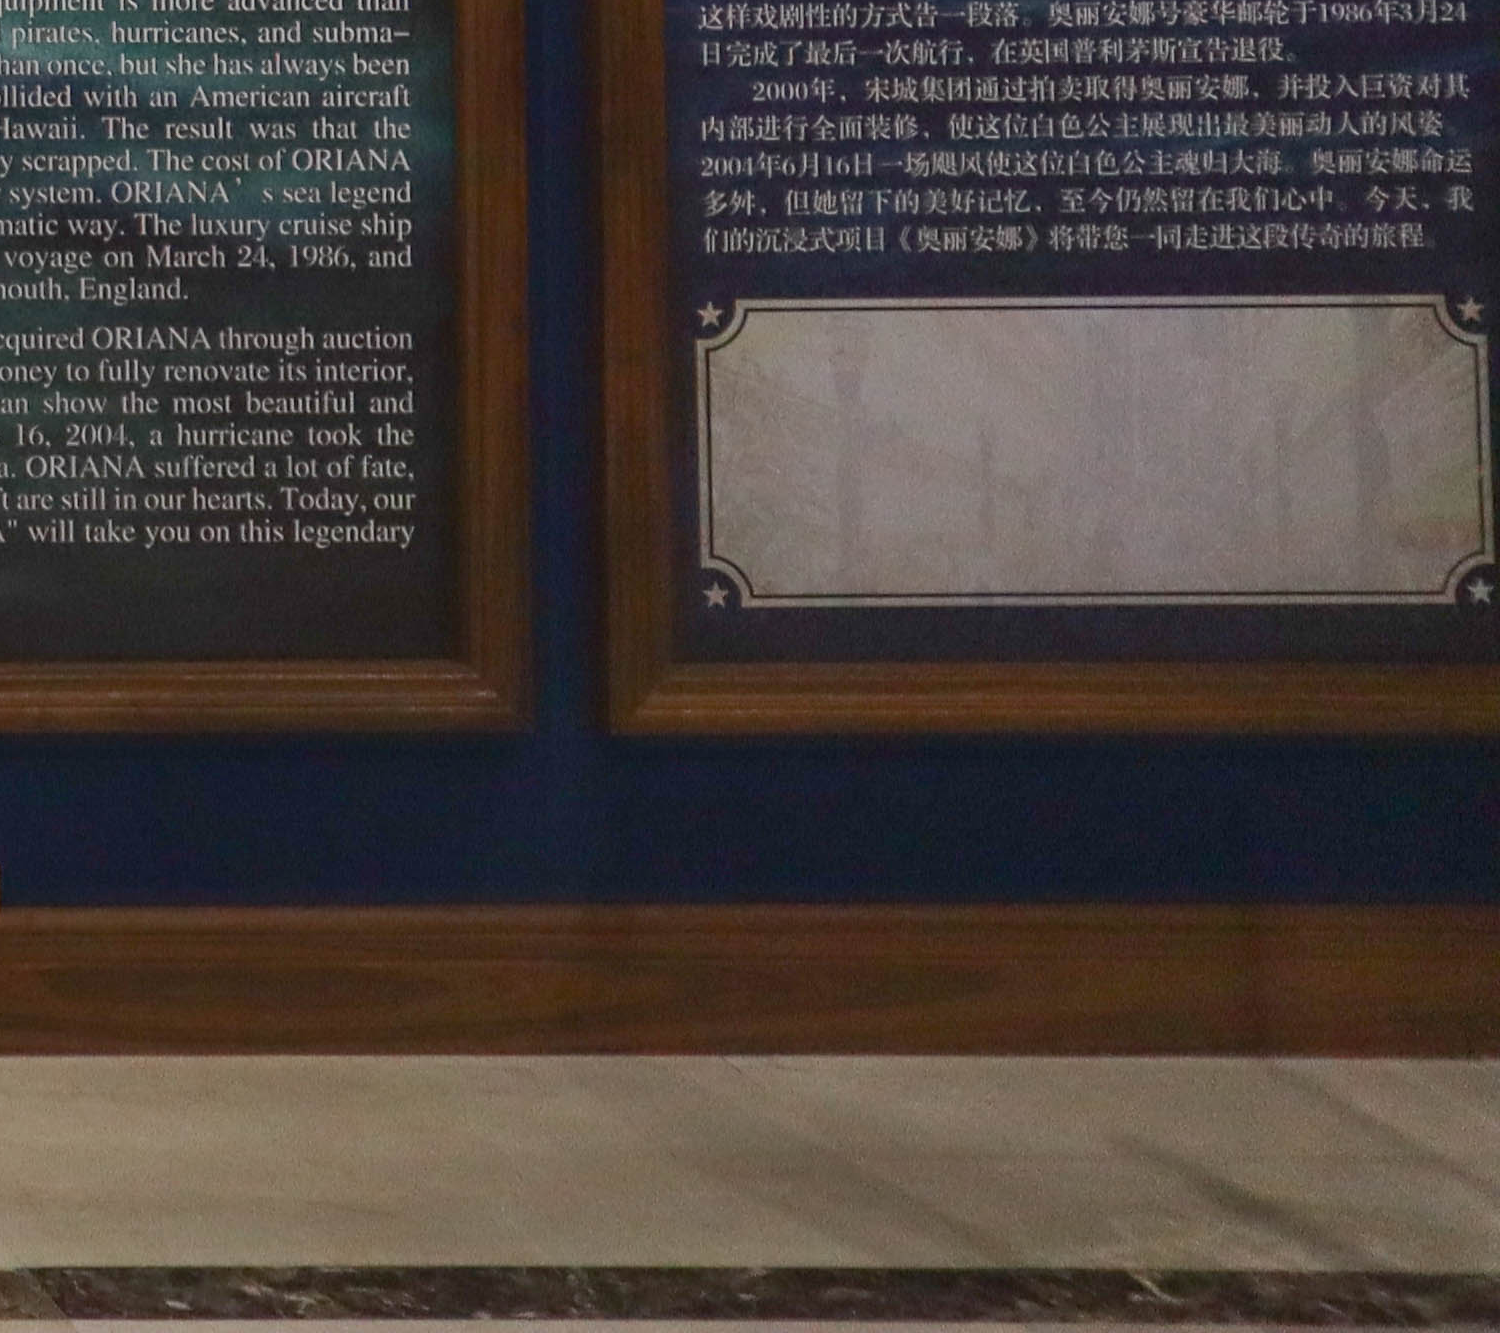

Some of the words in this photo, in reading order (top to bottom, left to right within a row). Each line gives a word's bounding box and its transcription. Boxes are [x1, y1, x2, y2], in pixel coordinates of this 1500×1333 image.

[67, 218, 125, 242] way.
[133, 212, 183, 237] The
[191, 212, 270, 242] luxury
[278, 211, 353, 236] cruise
[360, 211, 413, 242] ship
[16, 423, 52, 448] 16,
[65, 423, 135, 449] 2004,
[149, 429, 163, 447] a
[176, 421, 294, 447] hurricane
[307, 422, 363, 447] took
[376, 421, 415, 447] the
[16, 493, 54, 511] are
[60, 486, 106, 511] still
[114, 486, 137, 511] in
[143, 493, 187, 511] our
[191, 486, 273, 511] hearts.
[279, 485, 367, 516] Today,
[373, 493, 417, 511] our
